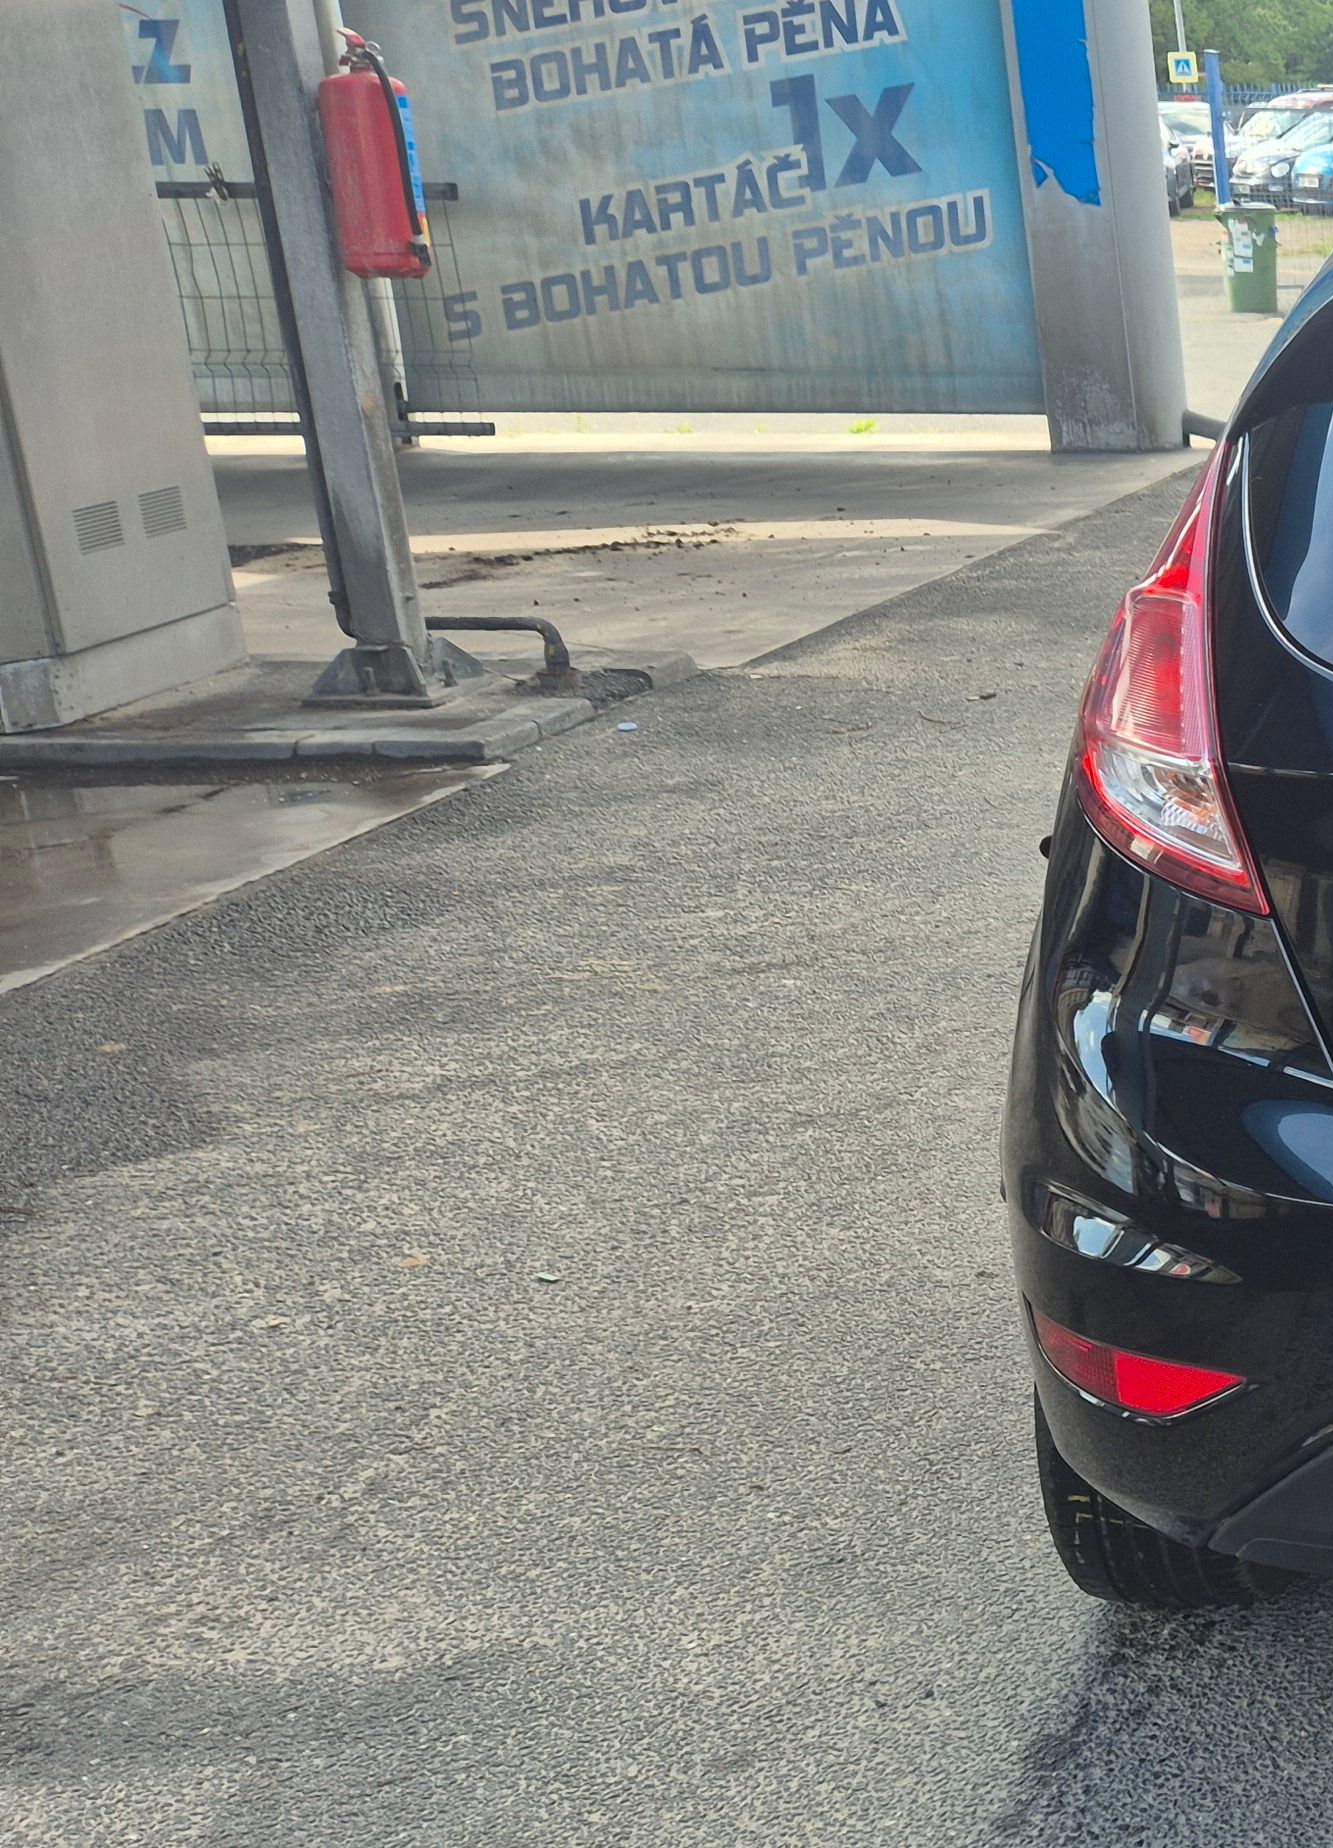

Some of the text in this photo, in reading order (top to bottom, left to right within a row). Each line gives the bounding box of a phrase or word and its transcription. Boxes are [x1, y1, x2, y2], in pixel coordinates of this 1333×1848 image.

[132, 19, 191, 84] Z
[490, 0, 900, 111] BOHATÁ PĚNA
[578, 152, 809, 246] KARTÁČ
[500, 236, 772, 331] BOHATOU
[792, 195, 988, 277] PĚNOU
